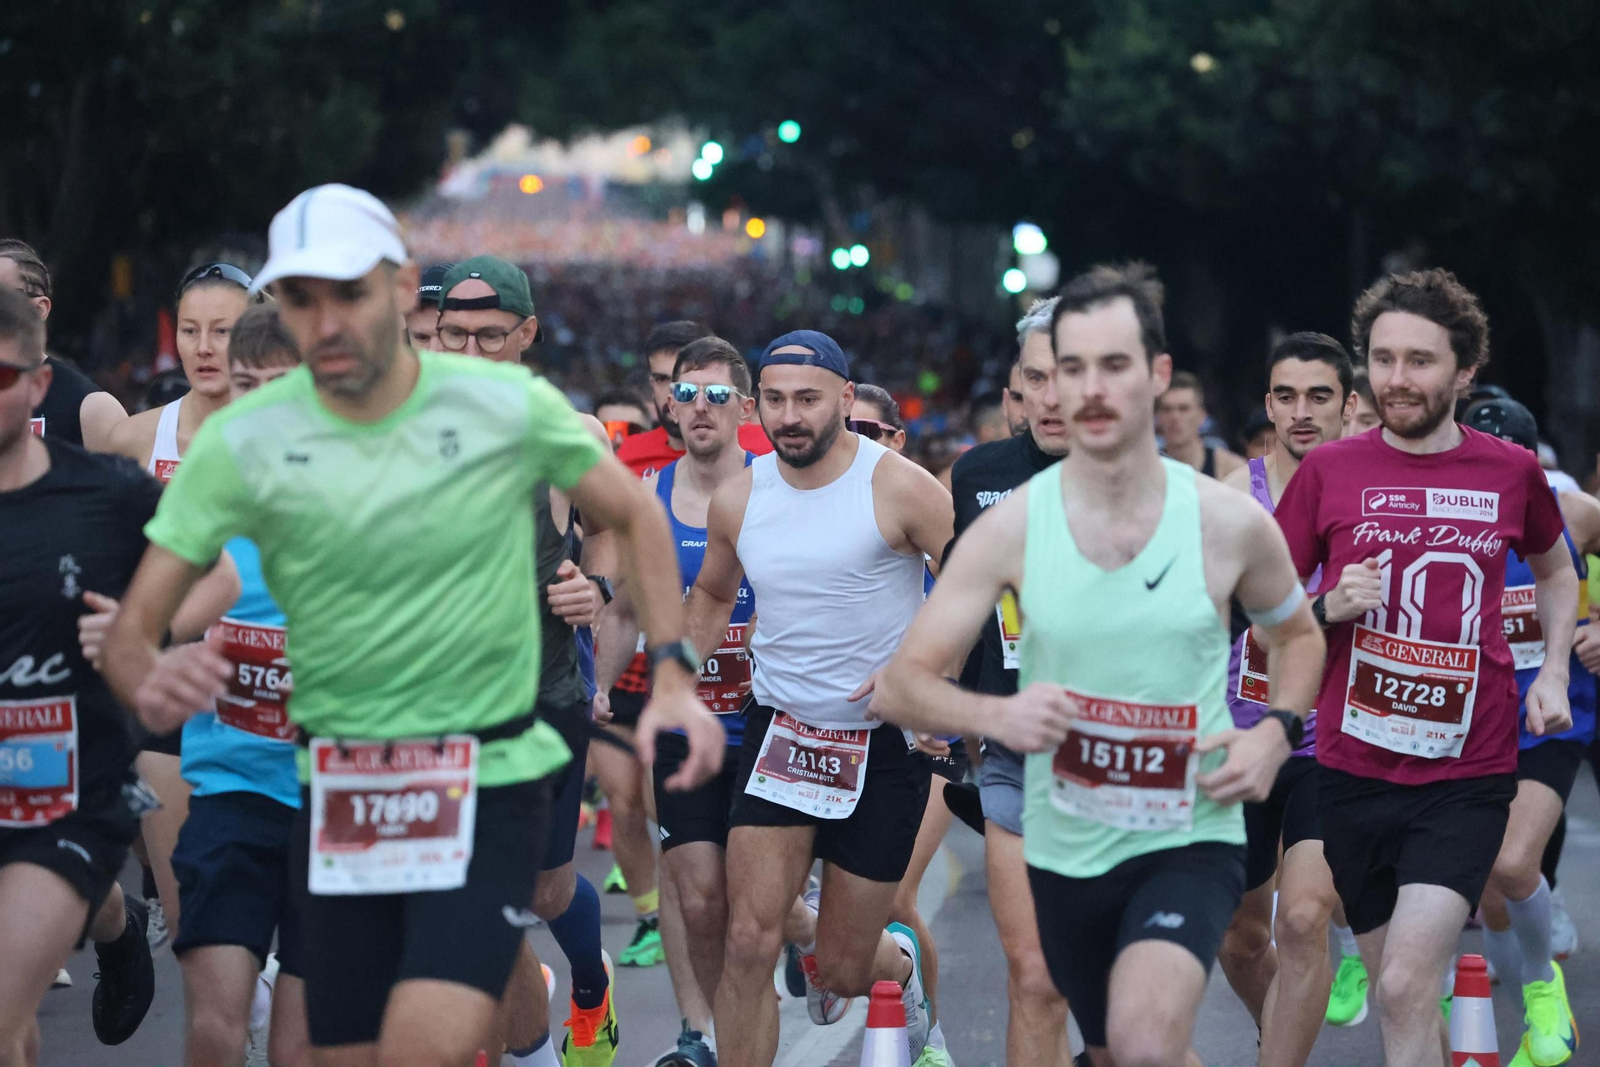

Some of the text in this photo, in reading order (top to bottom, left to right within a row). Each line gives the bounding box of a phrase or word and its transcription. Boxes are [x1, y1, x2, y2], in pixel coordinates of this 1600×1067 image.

[1387, 501, 1420, 511] Airtricity
[1432, 493, 1494, 510] DUBLIN
[1353, 521, 1422, 546] Frank
[1501, 617, 1525, 635] 51
[1384, 641, 1470, 669] GENERALI
[1374, 672, 1447, 707] 12728
[0, 706, 64, 730] ERALI
[1089, 702, 1191, 729] GENERALI
[1391, 701, 1418, 714] DAVID
[1426, 730, 1447, 740] 21K
[786, 745, 842, 775] 14143
[1078, 737, 1166, 774] 15112
[786, 765, 819, 780] CRISTIAN
[825, 794, 843, 804] 21K
